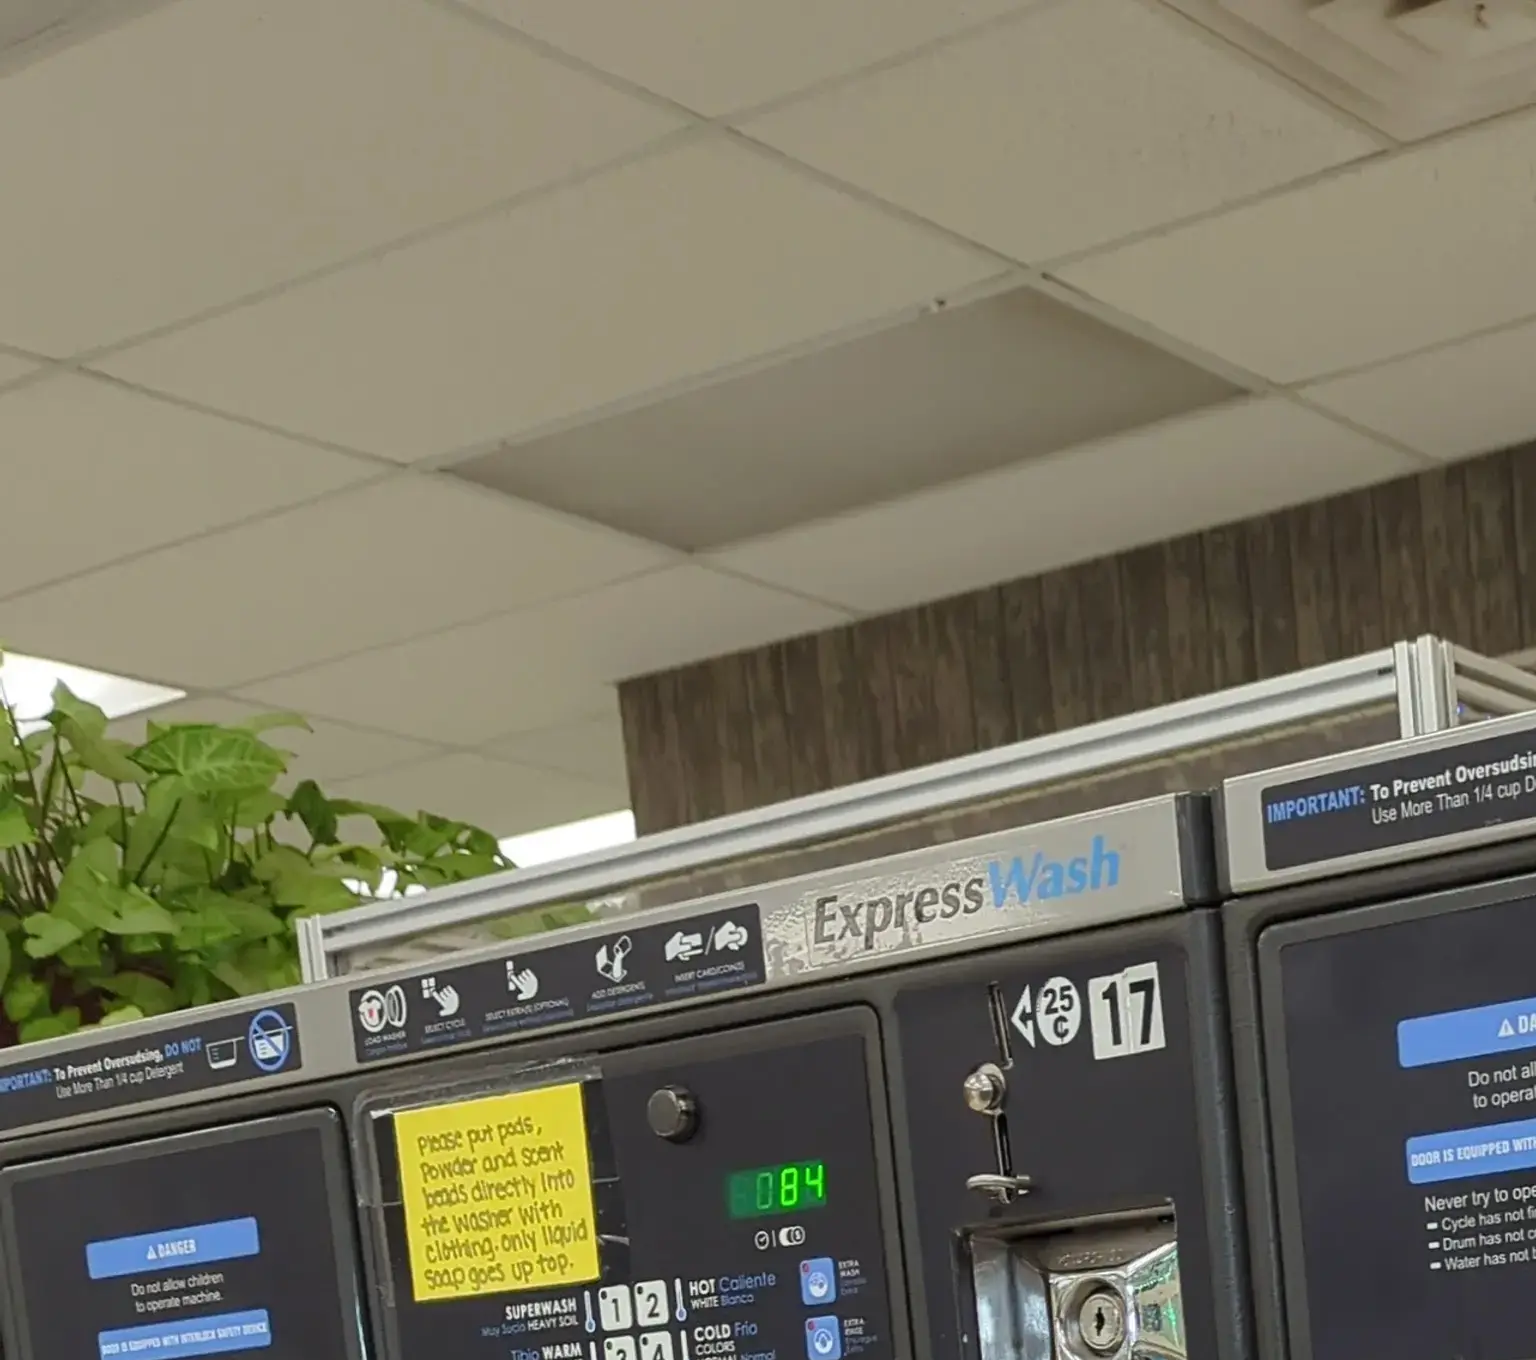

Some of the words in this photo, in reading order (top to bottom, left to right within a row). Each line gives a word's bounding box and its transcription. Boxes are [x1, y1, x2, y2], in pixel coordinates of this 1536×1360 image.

[1267, 788, 1365, 823] IMPORTANT:
[1370, 784, 1389, 801] To
[1393, 771, 1451, 800] Prevent
[1372, 806, 1396, 825] Use
[1401, 800, 1433, 819] More
[1437, 791, 1469, 812] Than
[1473, 785, 1493, 804] 1/4
[1497, 783, 1520, 803] cup
[1044, 986, 1073, 1016] 25
[1102, 978, 1155, 1046] 17
[1468, 1071, 1489, 1087] Do
[1494, 1066, 1517, 1083] not
[1473, 1093, 1487, 1108] to
[417, 1130, 462, 1156] Please
[467, 1124, 494, 1153] put
[497, 1116, 542, 1145] pods,
[482, 1147, 518, 1173] and
[521, 1141, 564, 1167] scent
[1411, 1151, 1441, 1167] DOOR
[1443, 1148, 1453, 1161] IS
[1457, 1138, 1510, 1160] EQUIPPED
[422, 1182, 468, 1210] beads
[472, 1175, 536, 1202] directly
[1425, 1196, 1468, 1212] Never
[1472, 1191, 1490, 1209] try
[1494, 1189, 1508, 1202] to
[421, 1214, 450, 1236] the
[519, 1199, 562, 1225] with
[1442, 1218, 1476, 1233] Cycle
[1479, 1213, 1501, 1226] has
[1504, 1210, 1524, 1222] not
[542, 1218, 587, 1247] liquid
[1443, 1236, 1476, 1251] Drum
[1479, 1232, 1501, 1246] has
[1504, 1229, 1524, 1242] not
[158, 1239, 196, 1258] DANGER
[1444, 1256, 1480, 1270] Water
[1484, 1252, 1506, 1266] has
[1510, 1248, 1530, 1262] not
[468, 1262, 505, 1291] goes
[512, 1260, 533, 1283] up
[537, 1253, 574, 1275] top.
[689, 1279, 716, 1296] HOT
[719, 1272, 776, 1292] Caliente
[506, 1298, 577, 1320] SUPERWASH
[612, 1298, 620, 1322] 1
[646, 1293, 659, 1318] 2
[694, 1324, 731, 1341] COLD
[542, 1343, 582, 1360] WARM
[696, 1342, 735, 1356] COLORS
